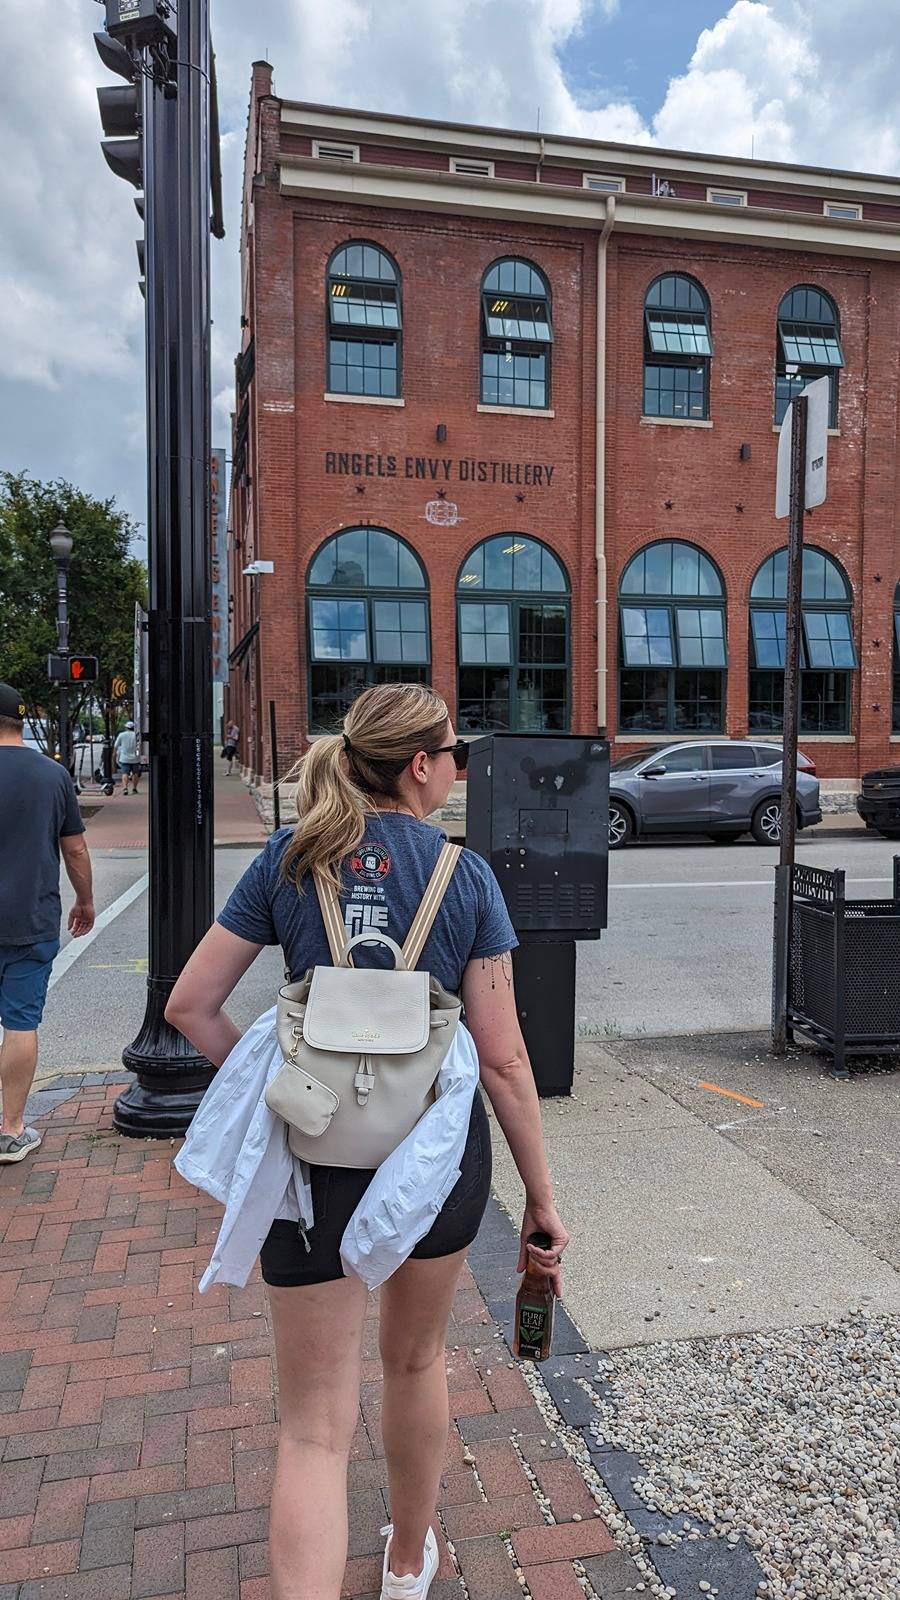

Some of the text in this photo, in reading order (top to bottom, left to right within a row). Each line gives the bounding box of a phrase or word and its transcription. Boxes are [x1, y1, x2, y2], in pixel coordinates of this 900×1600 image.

[405, 456, 452, 481] ENVY
[459, 460, 555, 487] DISTILLERY
[353, 885, 385, 894] BREWING UP
[351, 892, 386, 902] HISTORY WITH
[522, 1311, 545, 1321] PURE
[522, 1317, 544, 1327] LEAF
